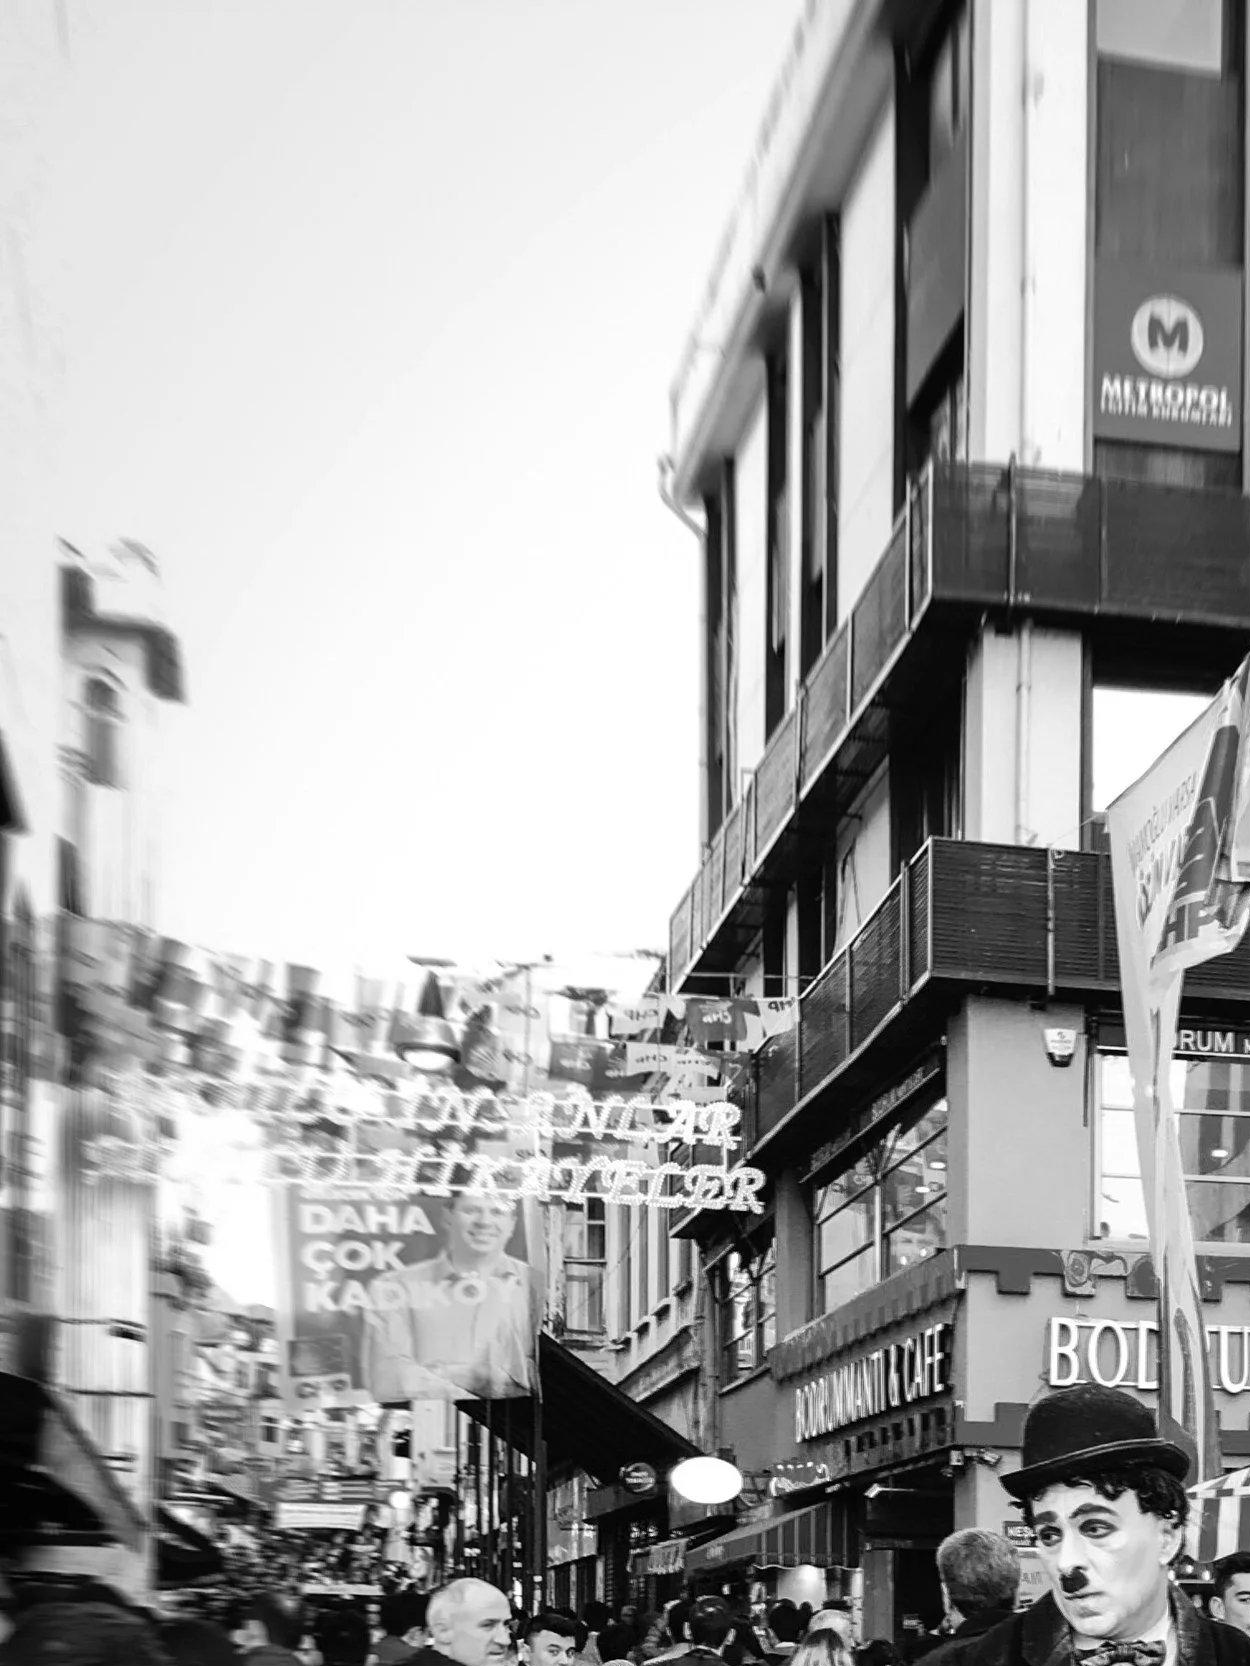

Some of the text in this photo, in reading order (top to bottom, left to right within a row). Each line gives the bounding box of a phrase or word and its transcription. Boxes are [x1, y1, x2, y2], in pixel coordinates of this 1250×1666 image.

[1147, 311, 1188, 355] M
[1100, 373, 1228, 410] METROPOL
[1180, 1029, 1234, 1052] RUM
[300, 1203, 436, 1235] DAHA
[302, 1240, 406, 1280] ÇOK
[305, 1270, 522, 1314] KADIKÖY
[904, 1323, 945, 1402] CAFE
